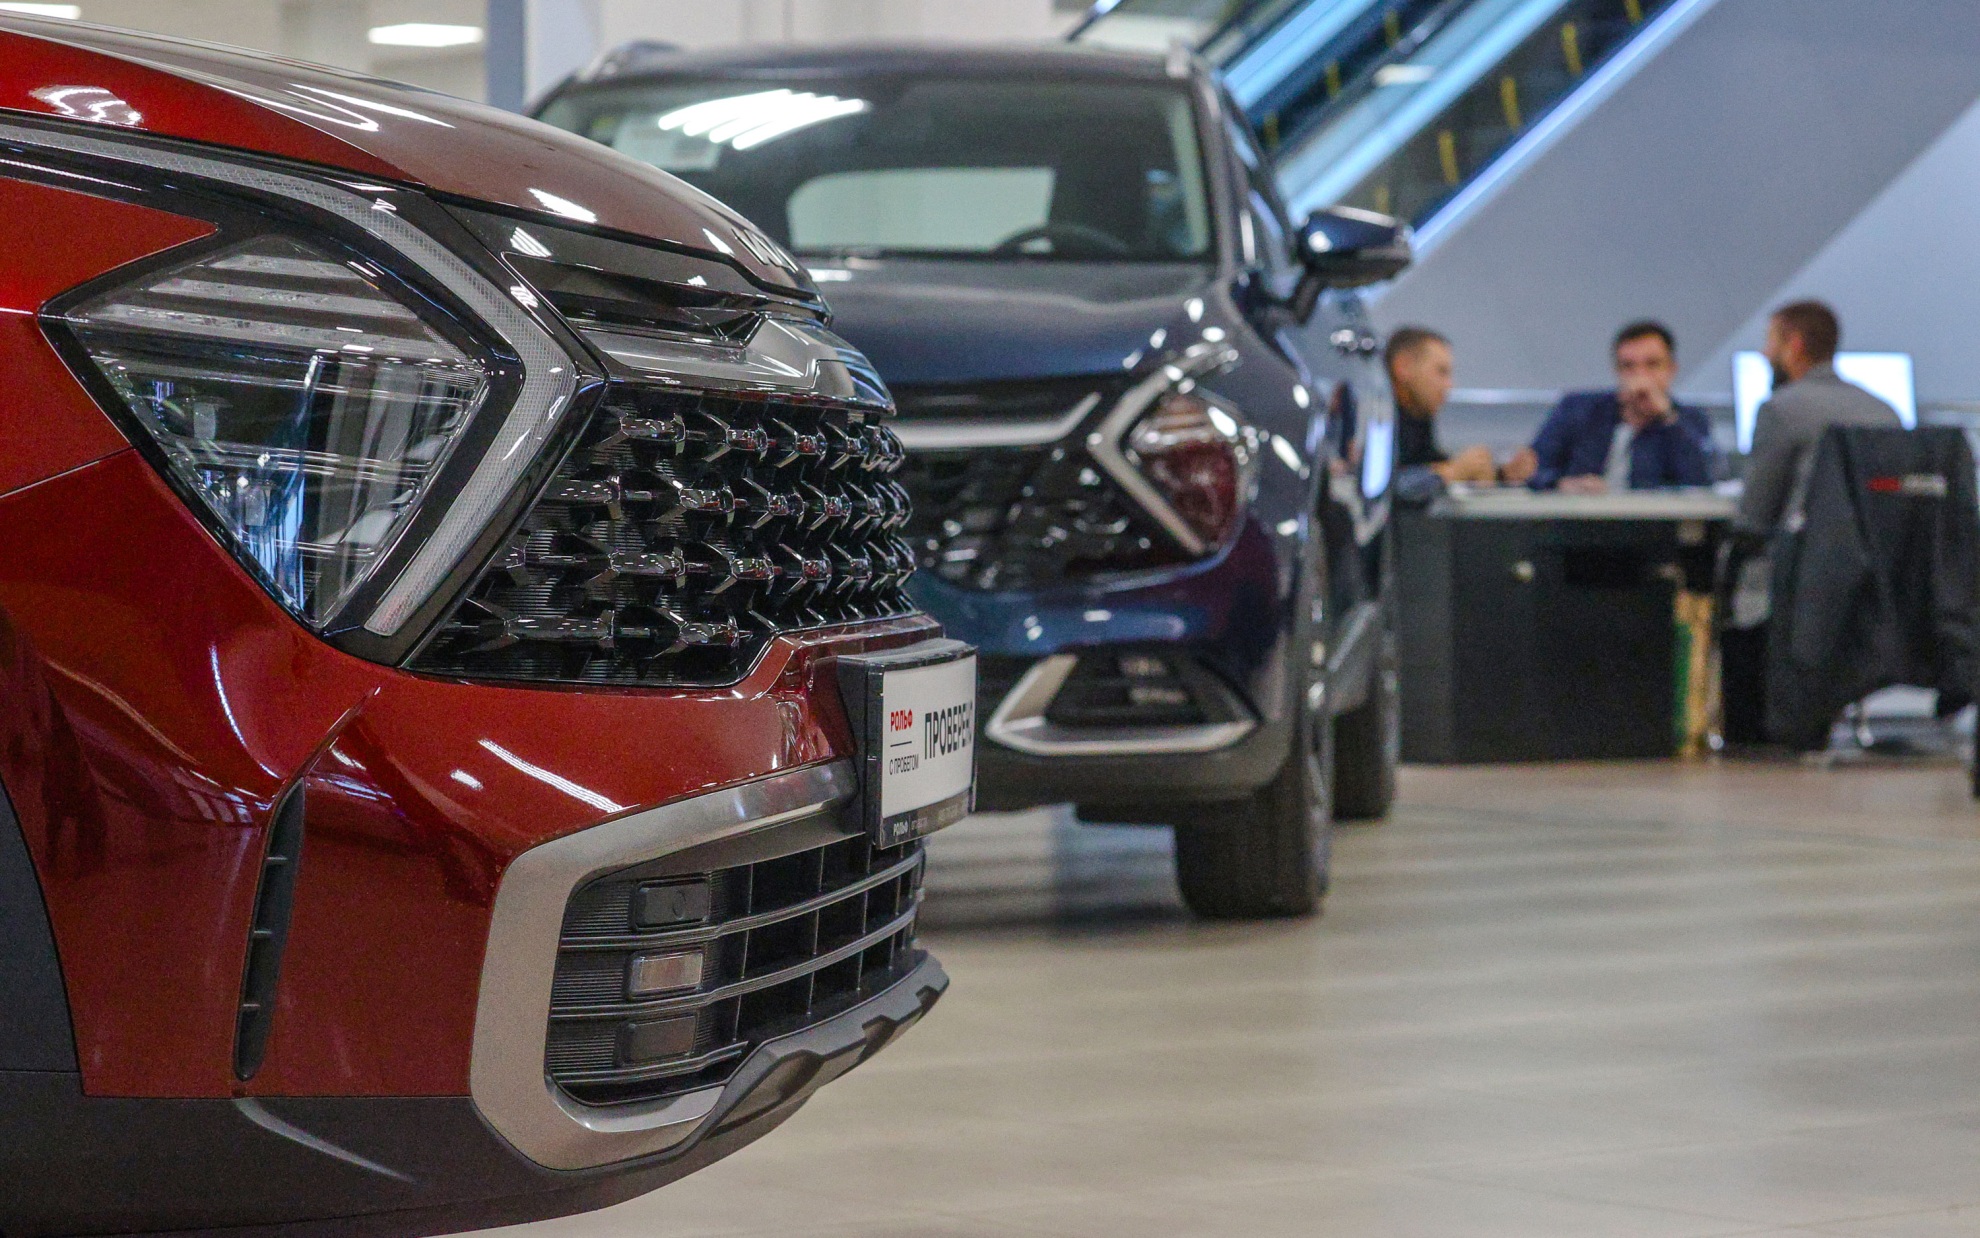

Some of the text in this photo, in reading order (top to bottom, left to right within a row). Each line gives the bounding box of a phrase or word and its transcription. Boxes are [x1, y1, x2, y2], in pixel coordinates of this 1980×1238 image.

[890, 709, 913, 732] РОЛЬФ
[889, 753, 919, 775] С ПРОБЕГОМ
